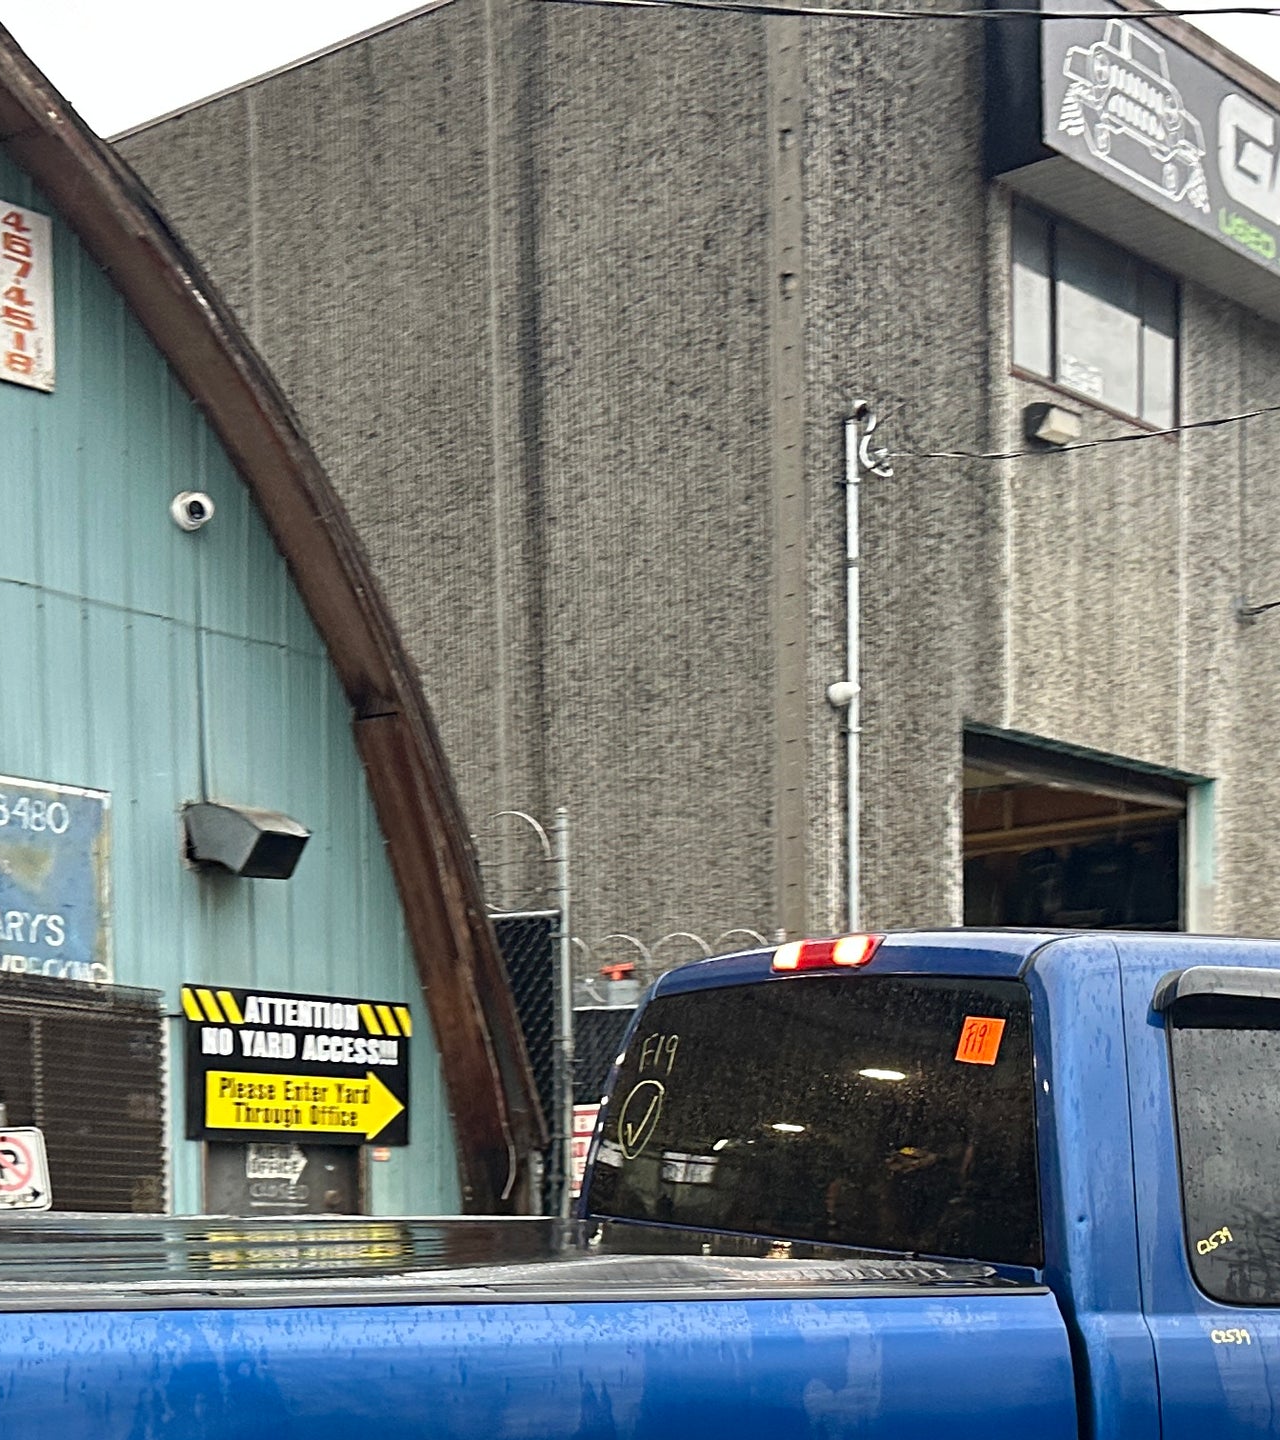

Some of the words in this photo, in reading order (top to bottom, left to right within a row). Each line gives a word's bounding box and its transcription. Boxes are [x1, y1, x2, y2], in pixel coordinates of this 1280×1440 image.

[244, 996, 360, 1031] ATTENTION
[202, 1027, 233, 1056] NO
[239, 1030, 296, 1059] YARD
[639, 1032, 679, 1077] F19
[218, 1077, 276, 1100] Please
[283, 1080, 328, 1103] Enter
[335, 1083, 371, 1105] Yard
[233, 1101, 302, 1128] Through
[309, 1104, 358, 1127] Office
